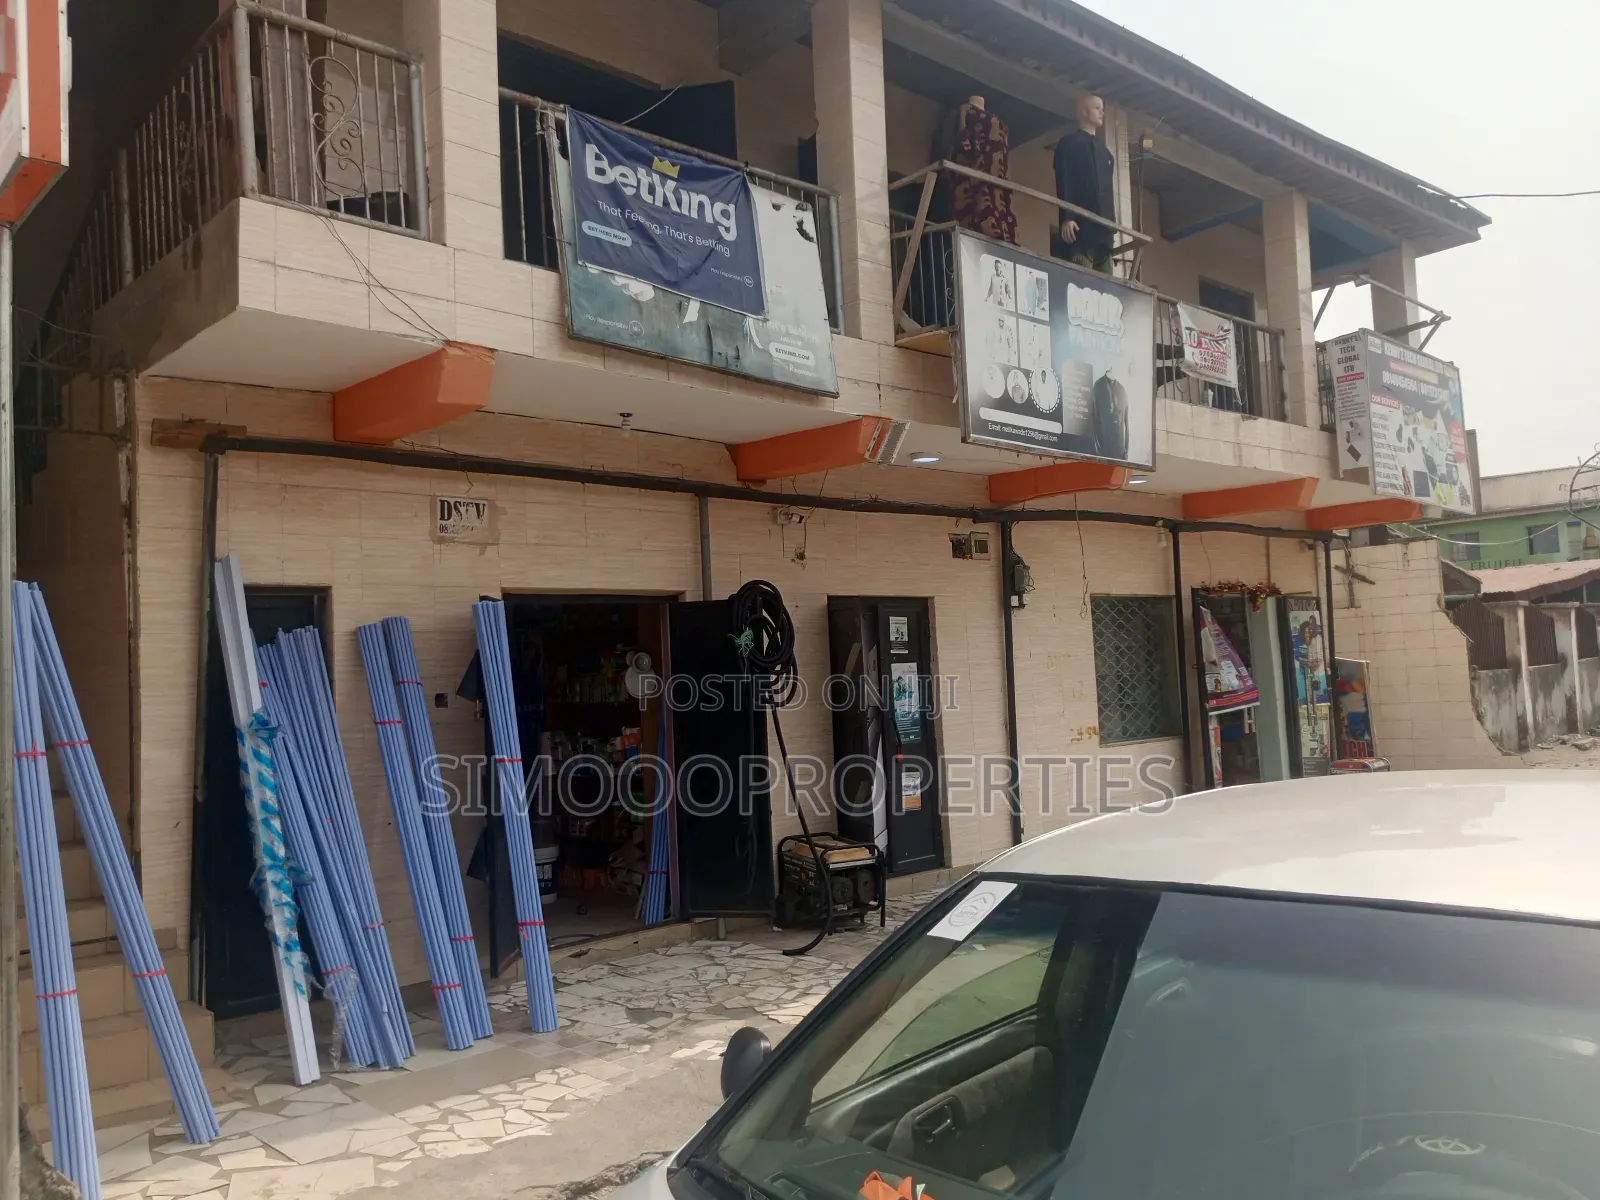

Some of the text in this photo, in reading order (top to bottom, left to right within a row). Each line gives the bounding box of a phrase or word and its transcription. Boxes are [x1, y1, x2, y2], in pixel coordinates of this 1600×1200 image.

[585, 143, 738, 241] BetKing
[597, 200, 623, 218] That
[625, 209, 662, 234] Feeng,
[664, 225, 694, 243] That's
[1337, 354, 1360, 365] GLOBAL
[1340, 345, 1356, 355] TECH
